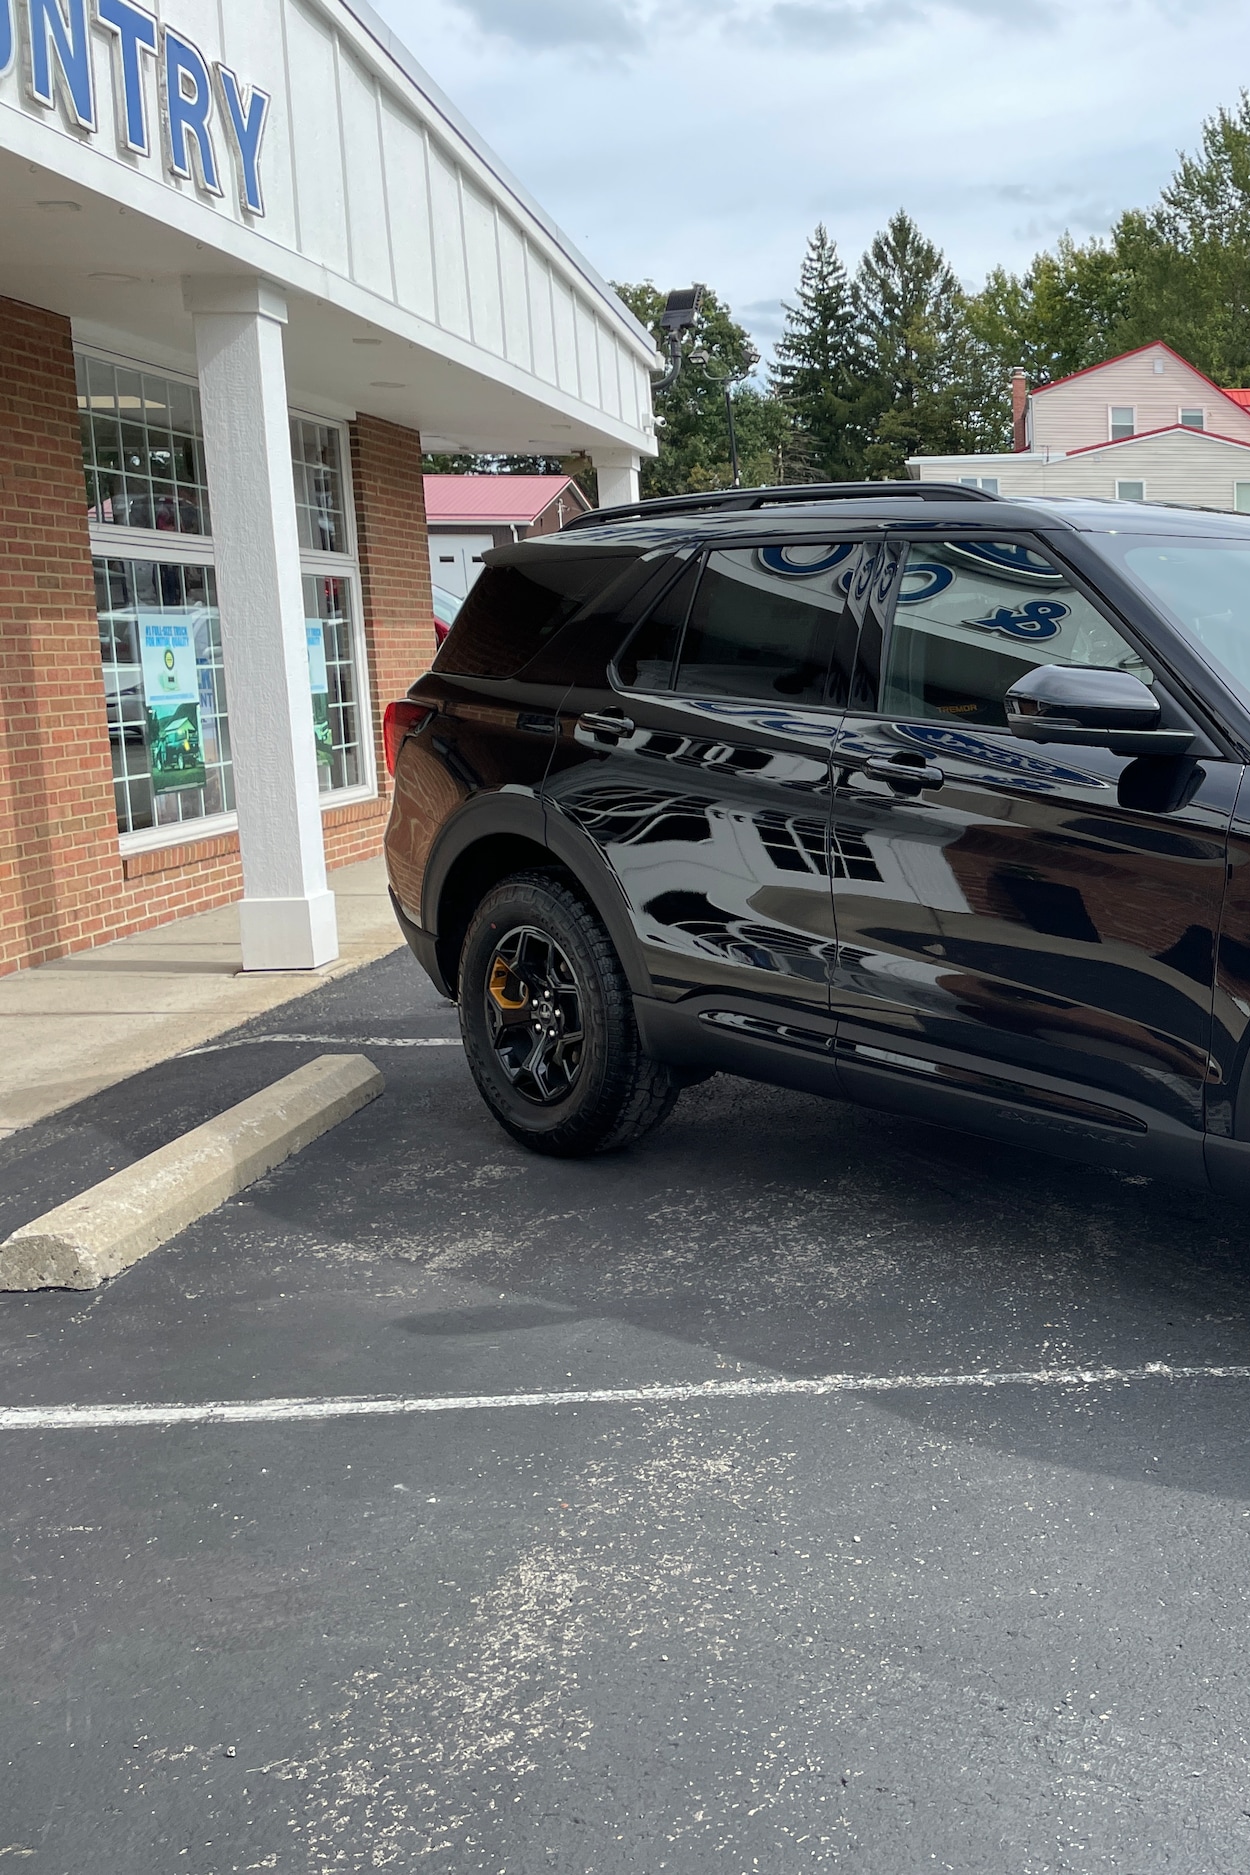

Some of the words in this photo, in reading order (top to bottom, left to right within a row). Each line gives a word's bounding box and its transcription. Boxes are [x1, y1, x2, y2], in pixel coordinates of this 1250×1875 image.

[173, 627, 188, 636] TRUCK
[145, 637, 155, 647] FOR
[172, 637, 190, 648] QUALITY
[937, 704, 978, 713] TREMOR
